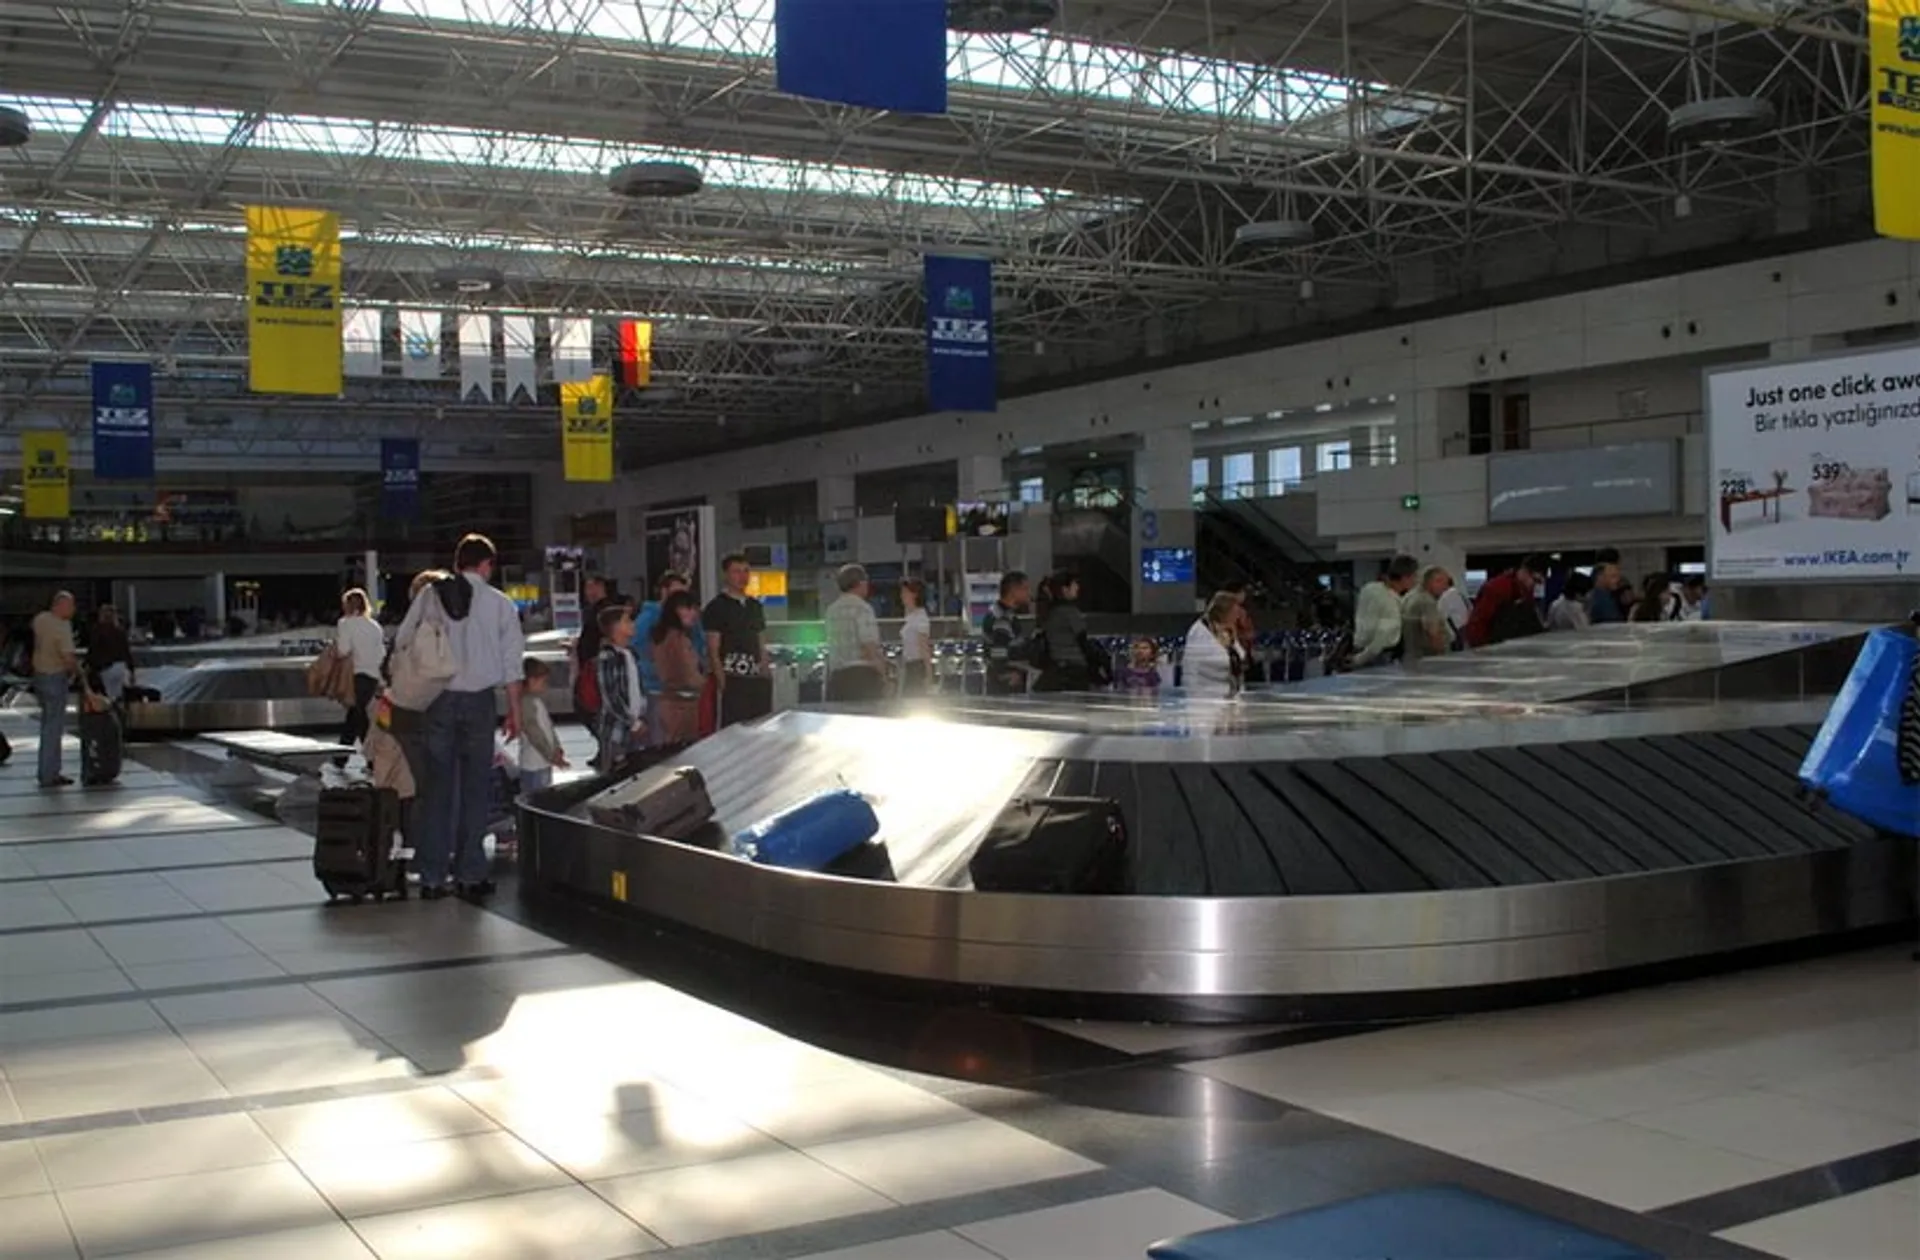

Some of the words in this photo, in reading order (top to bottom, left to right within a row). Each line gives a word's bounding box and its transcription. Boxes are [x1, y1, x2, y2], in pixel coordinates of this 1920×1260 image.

[256, 281, 333, 298] TEZ
[932, 316, 988, 332] TEZ
[1746, 387, 1783, 408] Just
[1789, 384, 1826, 402] one
[1831, 374, 1876, 397] click
[96, 407, 148, 418] TEZ
[1754, 411, 1778, 432] Bir
[1811, 463, 1841, 483] 539
[1141, 510, 1158, 541] 3
[1784, 550, 1910, 566] www.IKEA.com.tr
